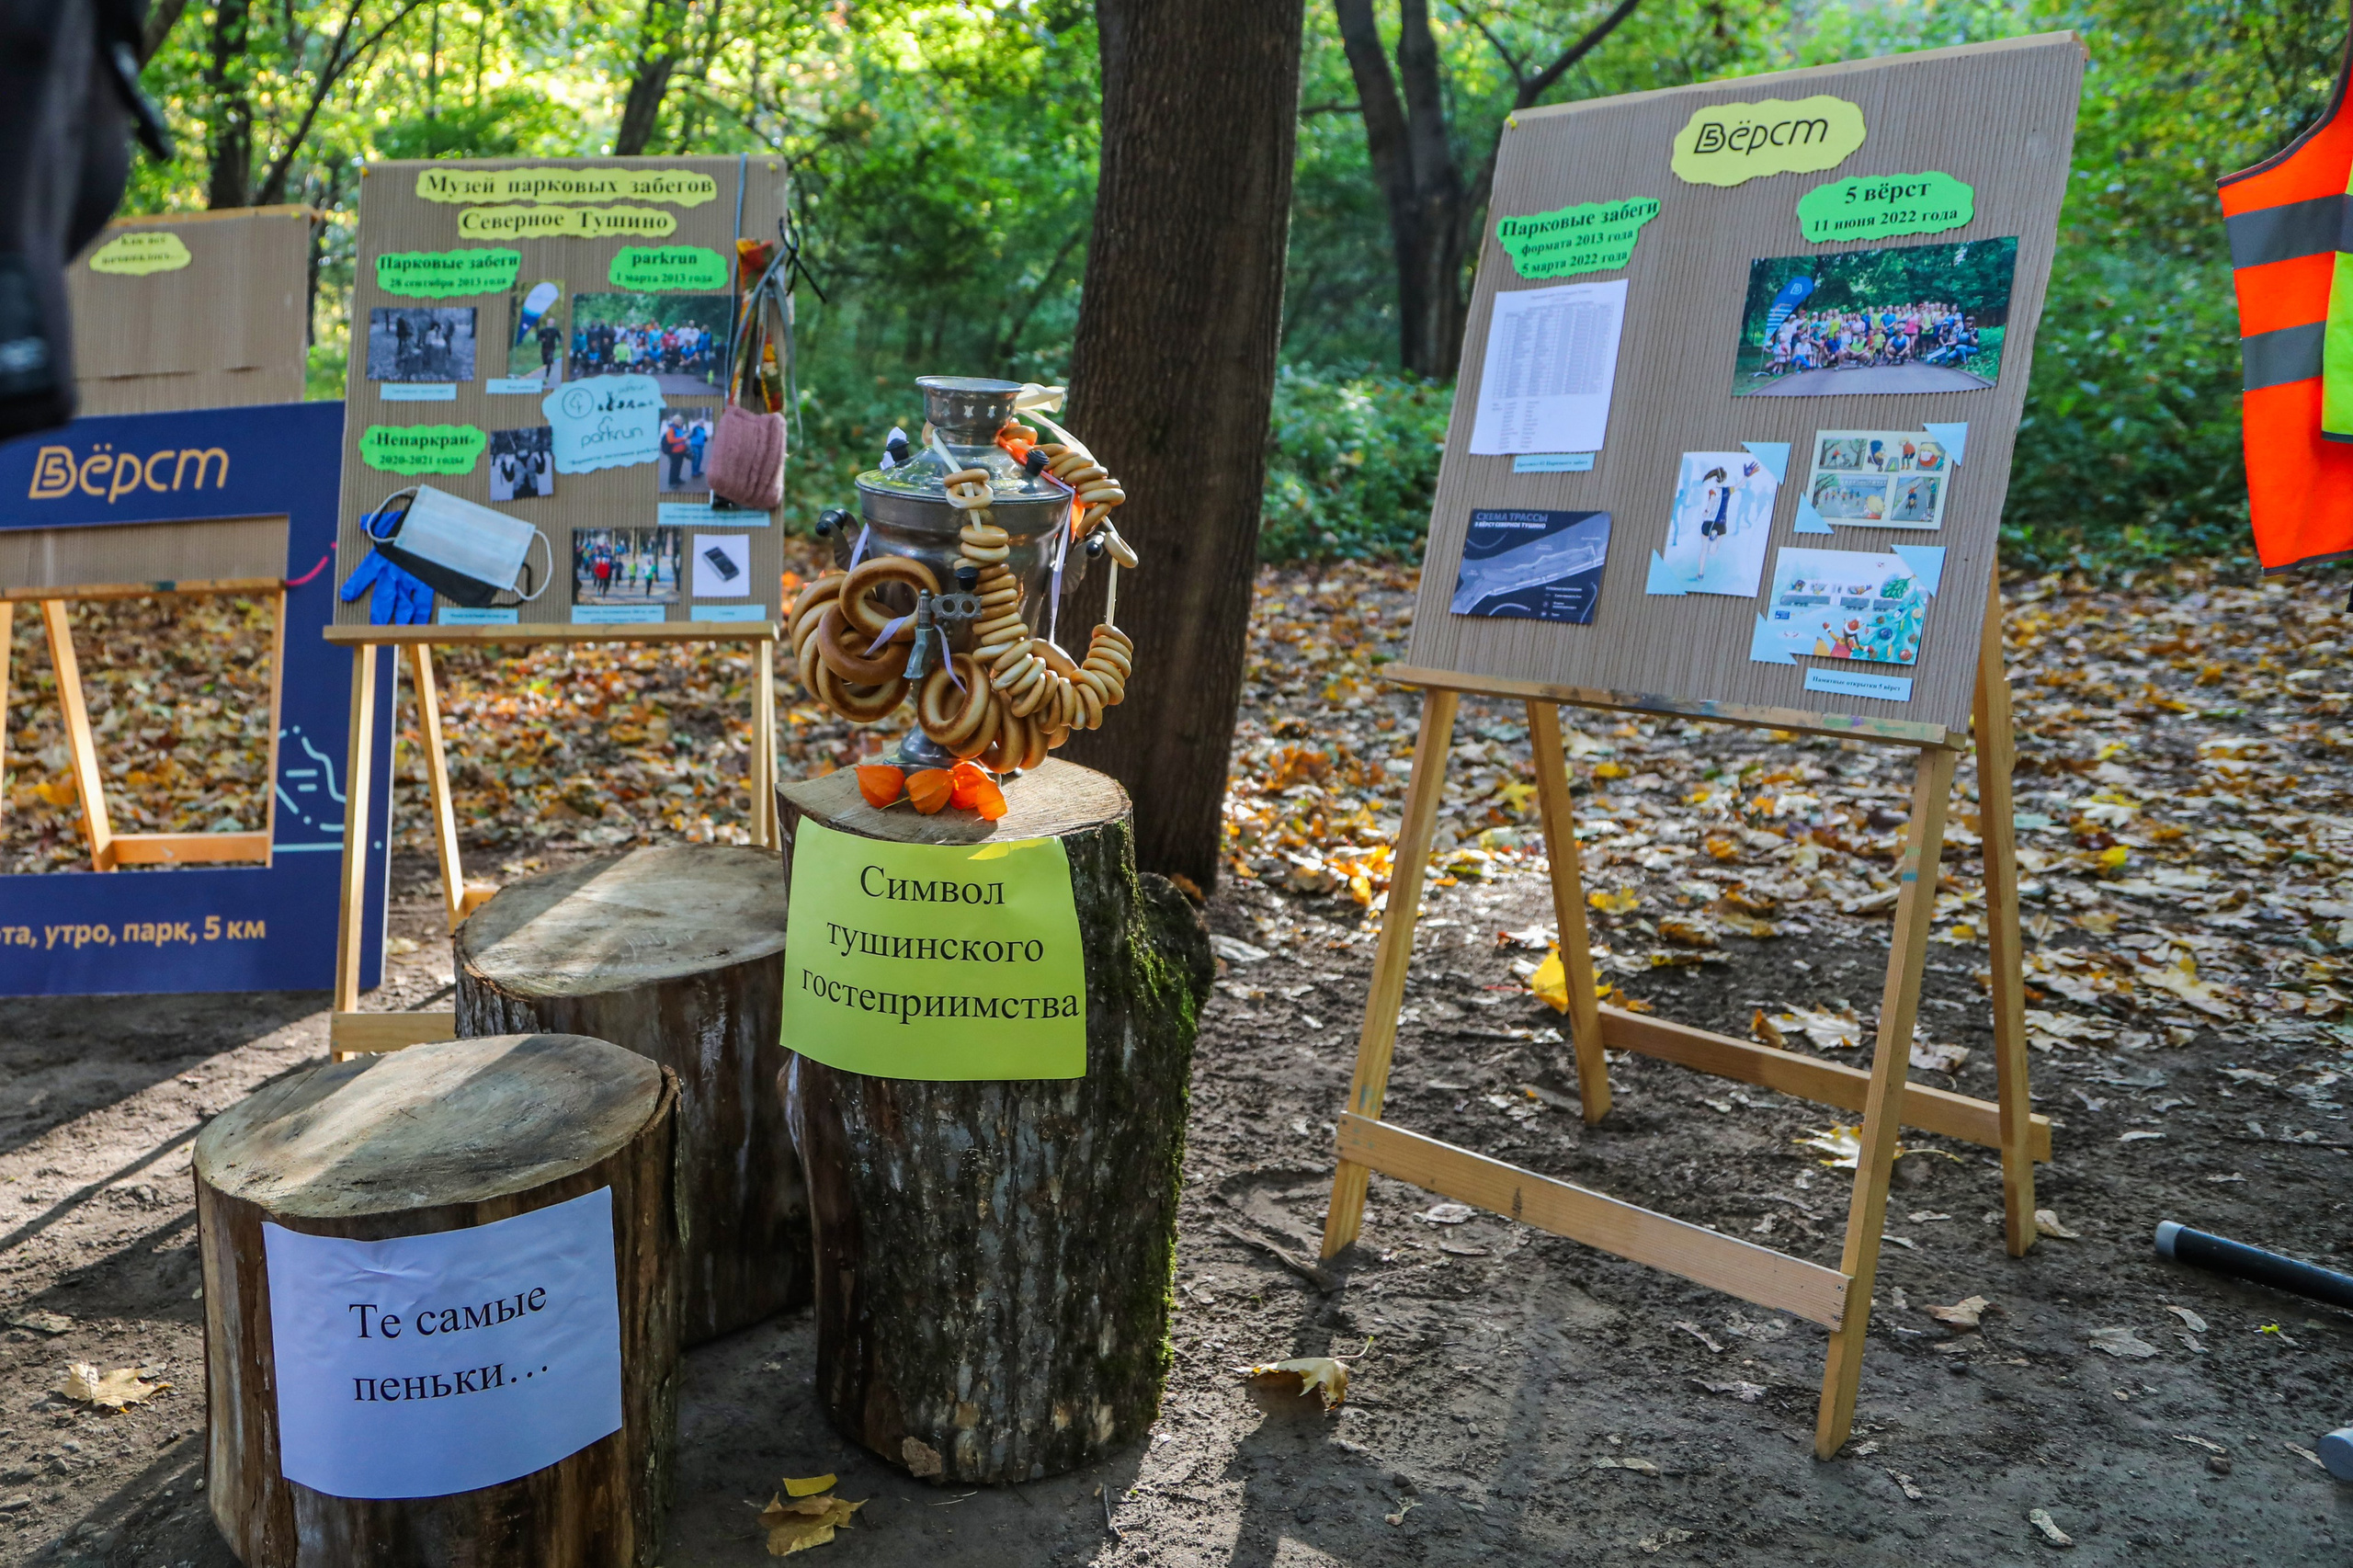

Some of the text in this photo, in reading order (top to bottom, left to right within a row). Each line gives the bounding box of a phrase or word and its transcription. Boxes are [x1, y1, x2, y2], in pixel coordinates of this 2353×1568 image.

[426, 175, 713, 197] Музей парковых забегов
[1844, 183, 1932, 205] 5 вёрст
[462, 210, 669, 233] Северное Тушино
[1502, 200, 1658, 239] Парковые забеги
[1813, 209, 1958, 233] 11 июня 2022 года
[1521, 230, 1633, 257] формата 2013 года
[380, 255, 518, 273] Парковые забеги
[632, 252, 698, 267] parkrun
[1521, 250, 1628, 274] 5 марта 2022 года
[389, 278, 507, 290] 28 сентября 2013 года
[625, 274, 659, 284] марта
[662, 273, 687, 282] 2013
[688, 275, 713, 283] года
[380, 455, 465, 465] 2020-2021 годы
[1476, 512, 1549, 522] СХЕМА ТРАССЫ
[859, 865, 1006, 905] Символ
[0, 915, 267, 950] та, утро, парк, 5 км
[827, 922, 1044, 963] тушинского
[801, 968, 1080, 1025] гостеприимства
[348, 1286, 548, 1339] Те самые
